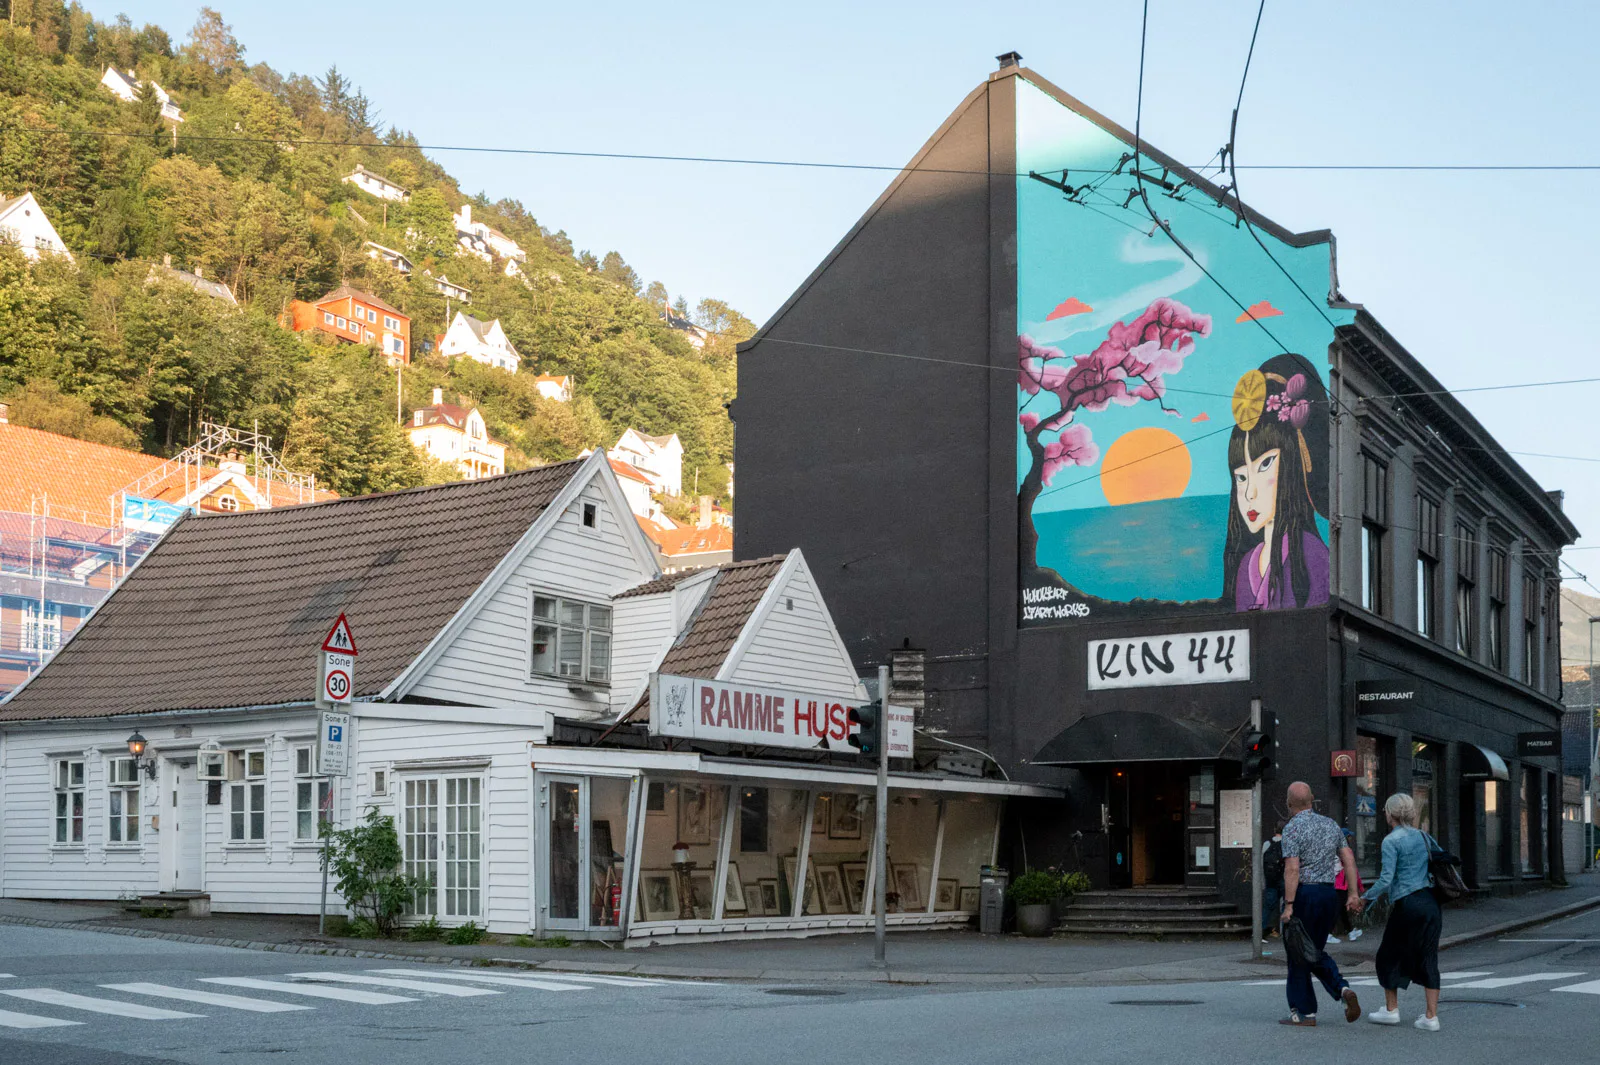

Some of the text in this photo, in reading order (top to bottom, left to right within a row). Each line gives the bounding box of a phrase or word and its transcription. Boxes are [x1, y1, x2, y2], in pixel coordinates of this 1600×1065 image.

[329, 654, 351, 667] Sone
[1097, 635, 1235, 680] KIN 44
[330, 677, 346, 692] 30
[1358, 692, 1414, 701] RESTAURANT
[701, 686, 784, 734] RAMME
[324, 714, 348, 724] Sone 6
